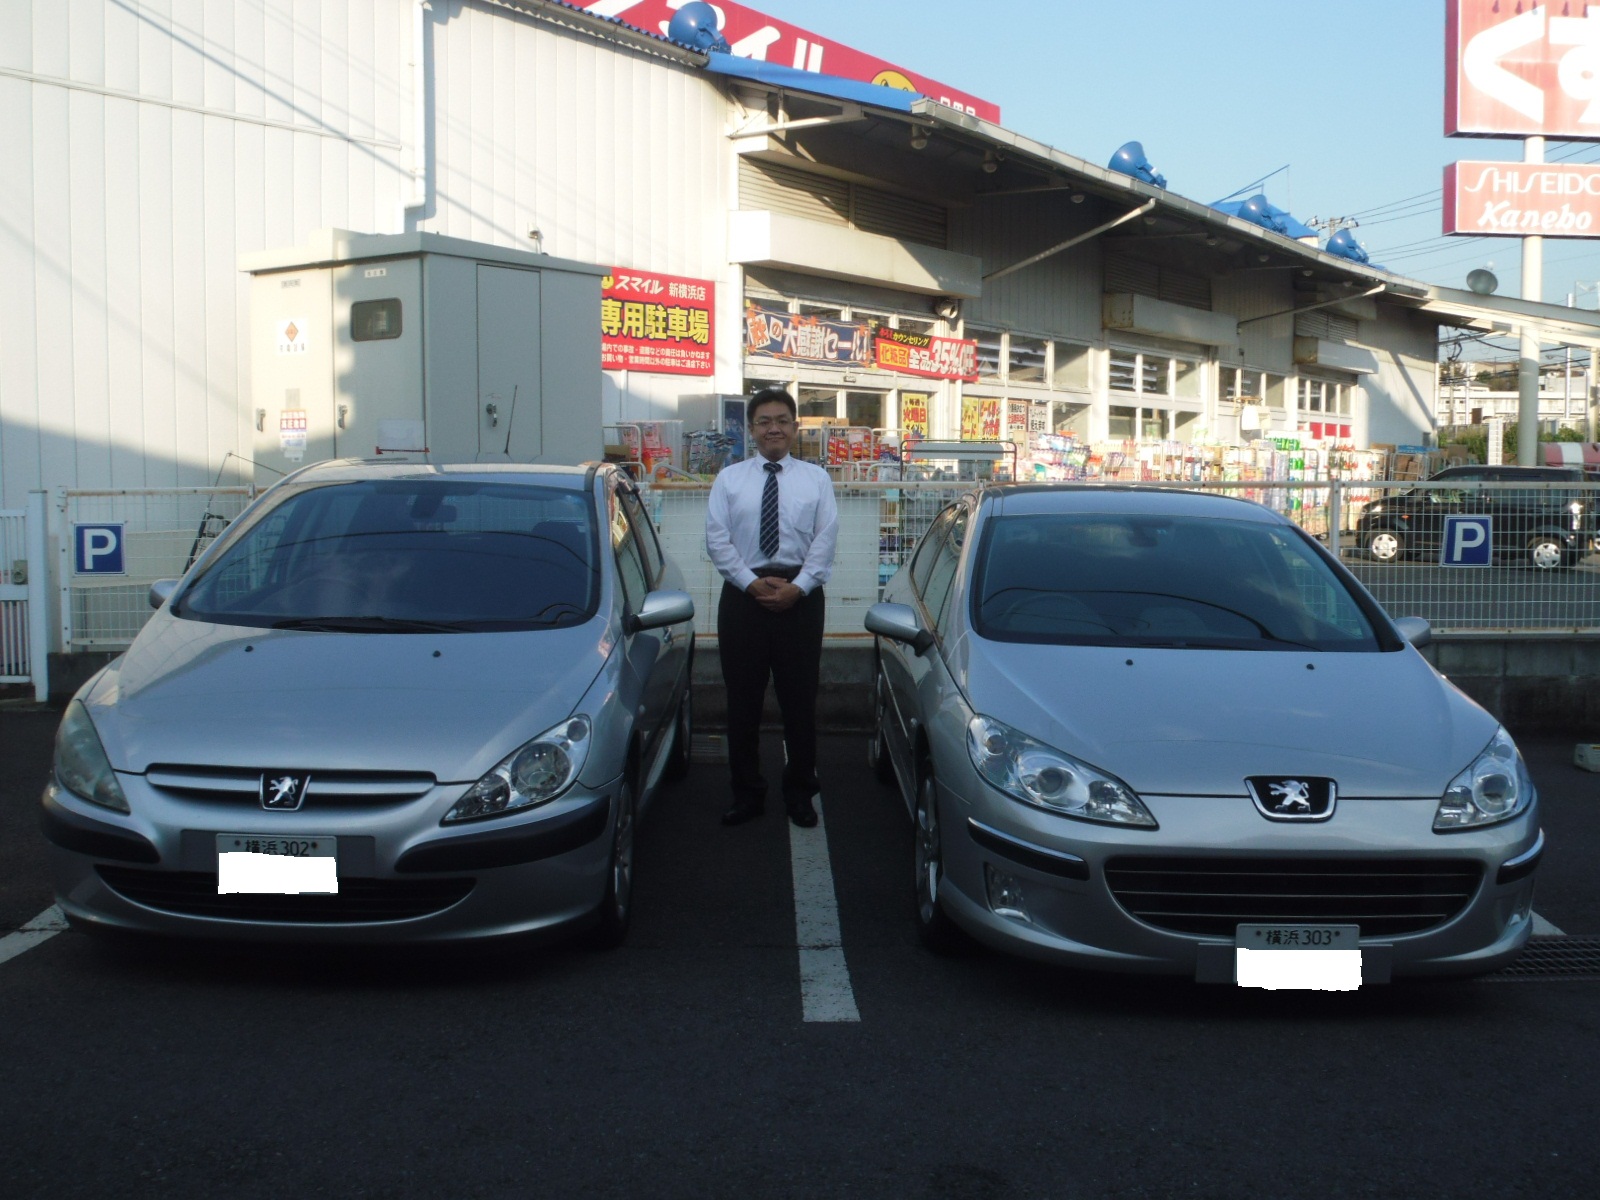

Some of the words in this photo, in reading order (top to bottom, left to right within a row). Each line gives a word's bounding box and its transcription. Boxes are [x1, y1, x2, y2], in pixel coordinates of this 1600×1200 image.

[1477, 201, 1593, 230] Kanebo
[615, 275, 665, 295] スマイル
[669, 282, 706, 300] 新横浜店
[601, 298, 710, 345] 専用駐車場
[882, 345, 908, 365] 化粧品
[903, 407, 927, 423] 火曜日
[84, 528, 117, 569] P
[1453, 521, 1486, 561] P
